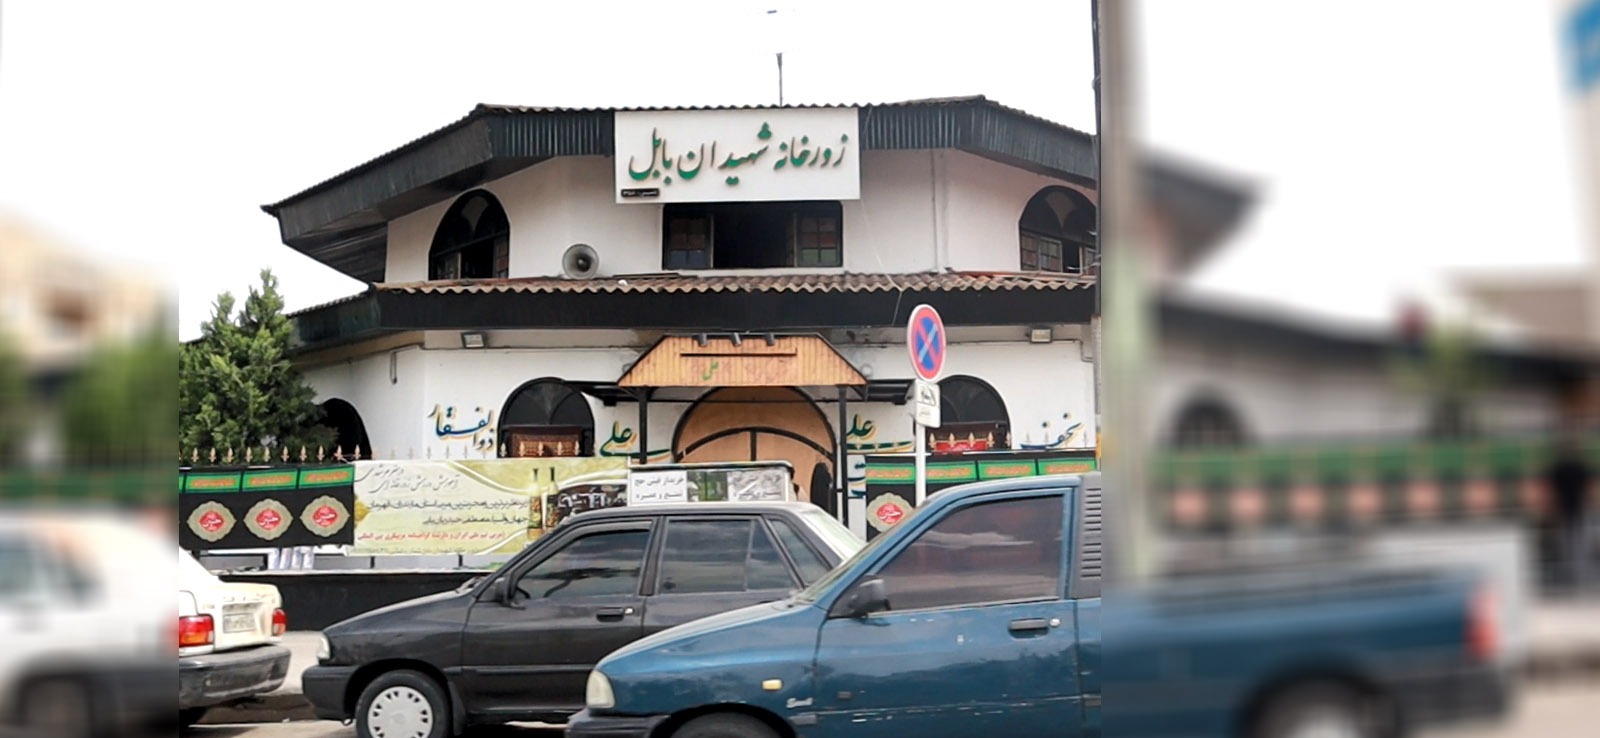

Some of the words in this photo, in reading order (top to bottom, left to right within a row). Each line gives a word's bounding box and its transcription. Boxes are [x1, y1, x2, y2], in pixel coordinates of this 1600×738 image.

[627, 126, 673, 185] بابل
[676, 121, 772, 185] شهیدان
[773, 133, 848, 171] زورخانه
[600, 420, 671, 458] علی
